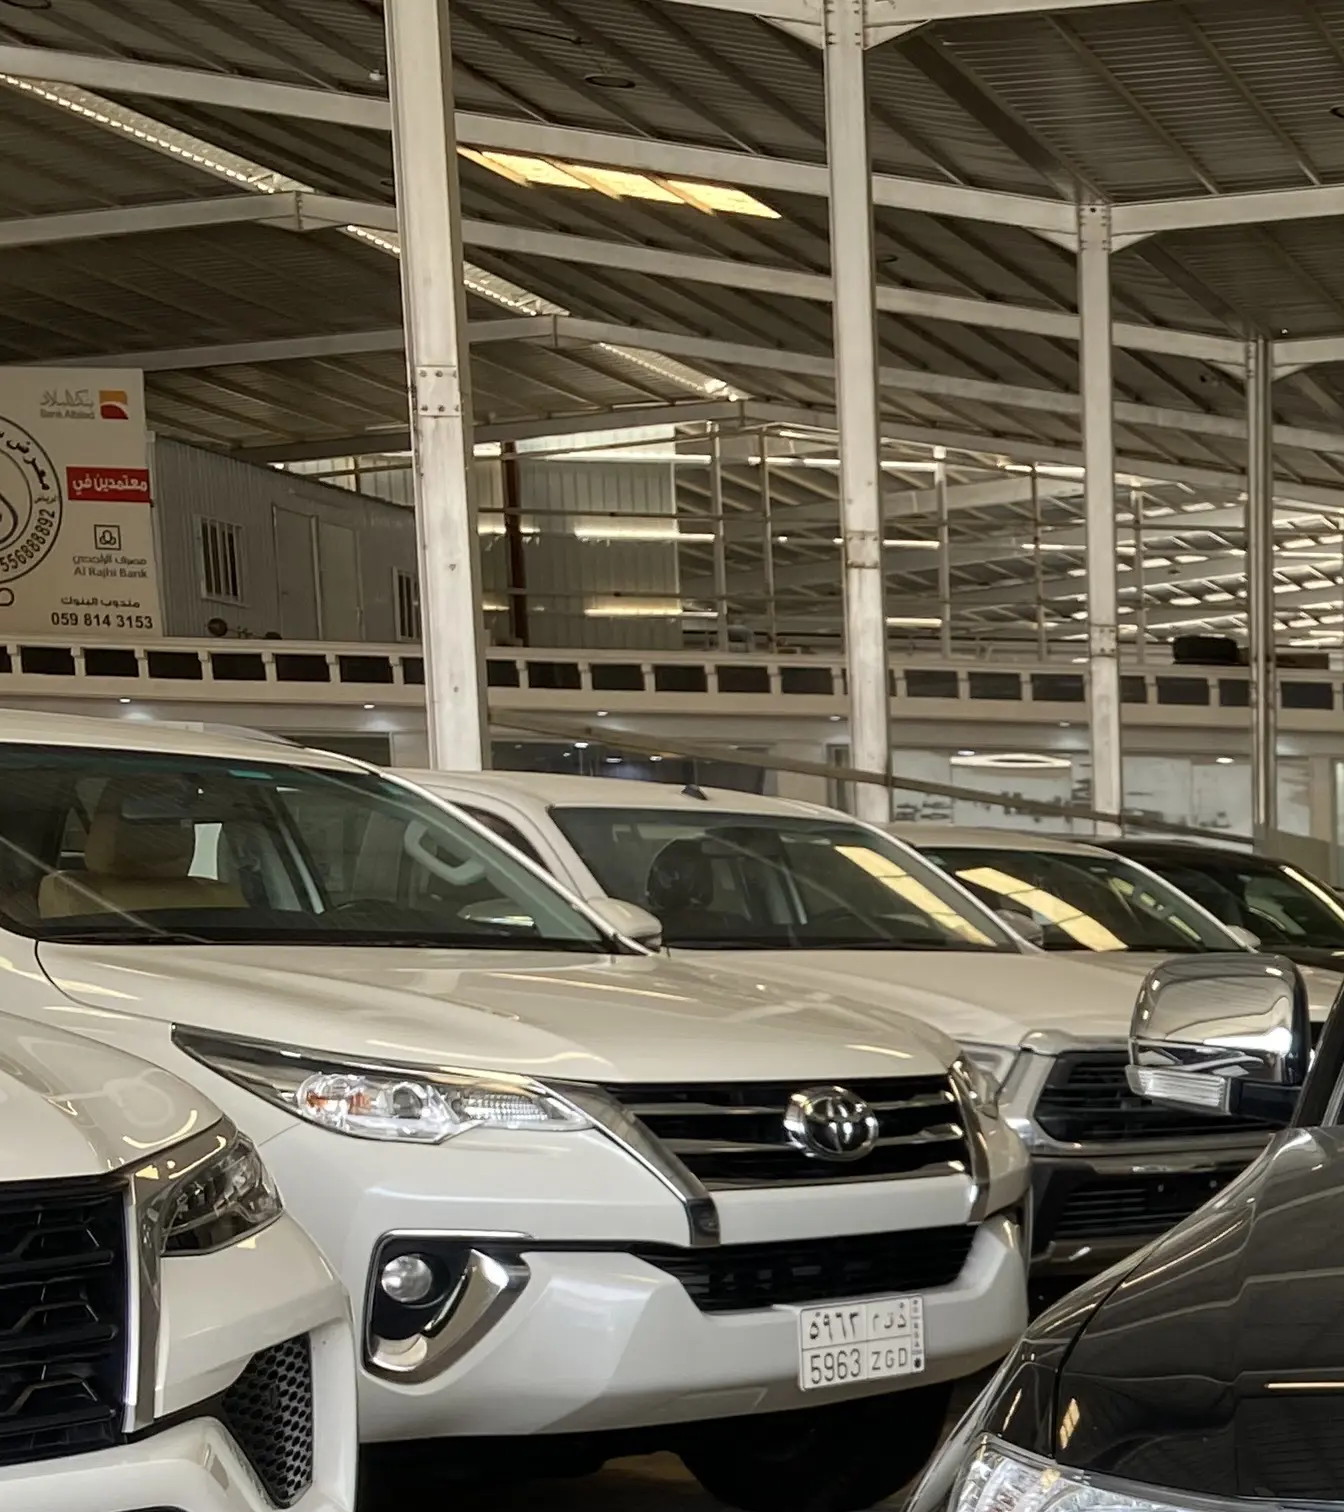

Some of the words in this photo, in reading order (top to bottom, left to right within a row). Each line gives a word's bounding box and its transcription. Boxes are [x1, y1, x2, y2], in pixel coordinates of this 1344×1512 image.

[72, 473, 93, 495] في
[94, 473, 148, 492] معتمدين
[119, 568, 147, 578] Bank
[51, 612, 79, 626] 059
[116, 614, 153, 629] 3153
[810, 1348, 862, 1385] 5963
[871, 1347, 908, 1371] ZGD
